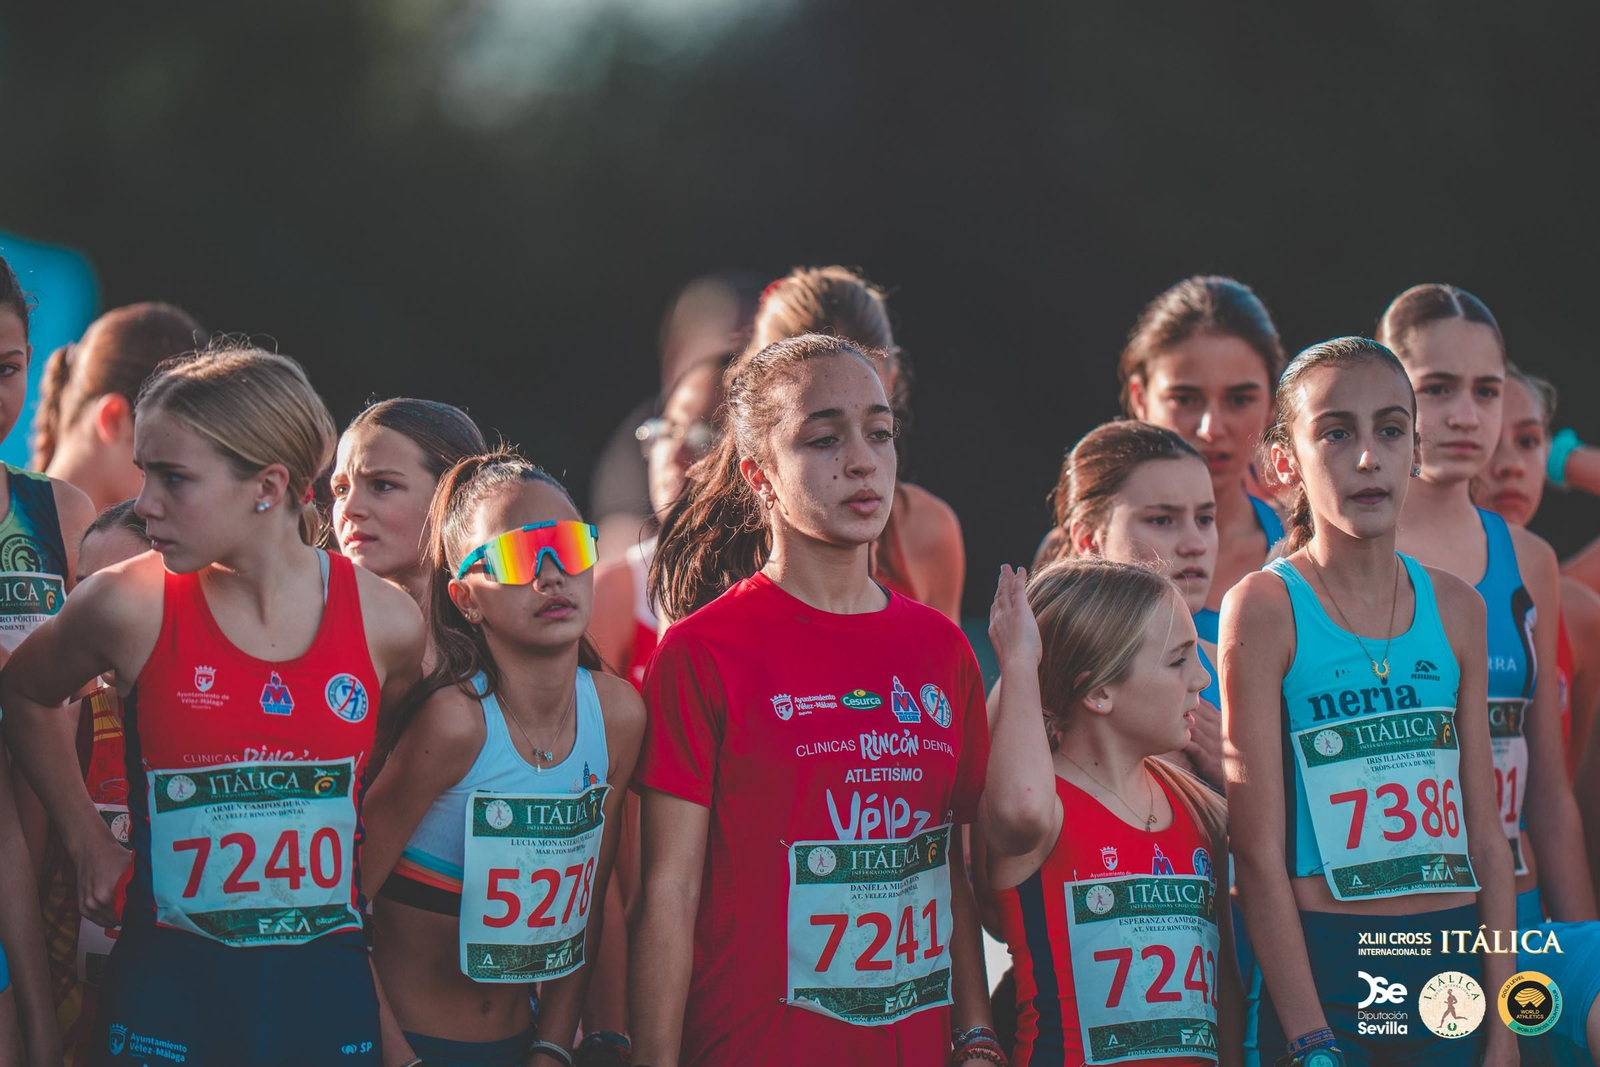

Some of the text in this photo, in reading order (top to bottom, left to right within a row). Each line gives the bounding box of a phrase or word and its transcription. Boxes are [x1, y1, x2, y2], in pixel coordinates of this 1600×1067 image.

[794, 694, 836, 704] Ayuntamiento
[842, 695, 882, 706] Cesurca
[1355, 717, 1437, 745] ITÁLICA
[795, 739, 856, 757] CLINICAS
[183, 753, 239, 763] CLINICAS
[1366, 757, 1383, 765] IRIS
[209, 769, 300, 795] ITÁLICA
[845, 767, 923, 783] ATLETISMO
[204, 804, 242, 814] CARMEN
[244, 801, 281, 810] CAMPOS
[225, 811, 248, 820] VELEZ
[249, 810, 278, 818] RINCON
[278, 808, 305, 816] DENTAL
[1330, 778, 1460, 850] 7386
[173, 827, 342, 899] 7240
[851, 843, 920, 870] ITÁLICA
[482, 856, 595, 928] 5278
[850, 883, 888, 891] DANIELA
[1128, 880, 1206, 905] ITÁLICA
[1119, 917, 1166, 926] ESPERANZA
[1167, 916, 1197, 924] CAMPOS
[809, 898, 945, 973] 7241
[130, 1032, 187, 1053] Ayuntamiento
[129, 1042, 186, 1063] Vélez-Málaga
